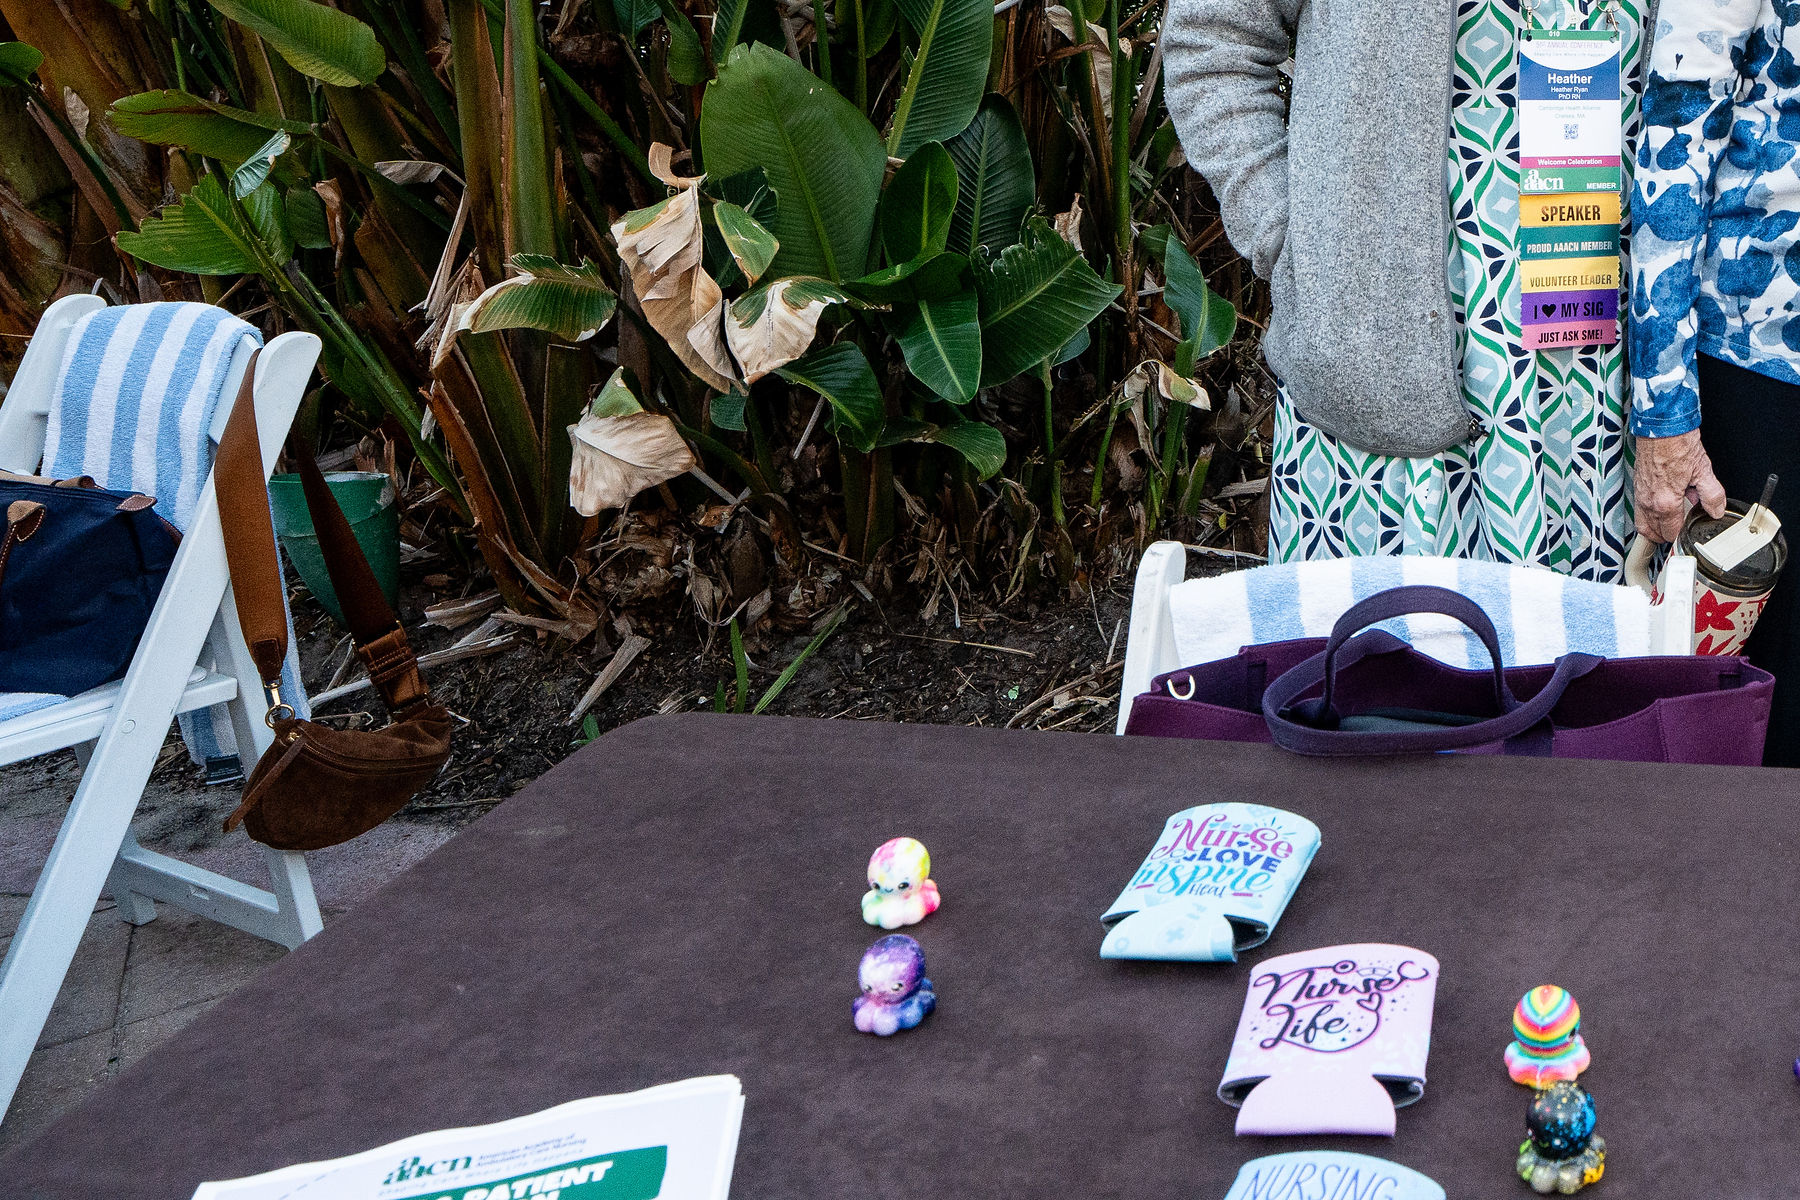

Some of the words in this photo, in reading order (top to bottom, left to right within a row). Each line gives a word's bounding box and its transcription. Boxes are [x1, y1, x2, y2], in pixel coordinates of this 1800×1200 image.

[1547, 73, 1592, 84] Heather
[1541, 205, 1600, 222] SPEAKER
[1527, 243, 1552, 254] PROUD
[1553, 242, 1579, 253] AAACN
[1581, 241, 1613, 251] MEMBER
[1530, 275, 1578, 287] VOLUNTEER
[1580, 274, 1612, 285] LEADER
[1534, 305, 1537, 319] I
[1561, 303, 1579, 318] MY
[1583, 301, 1604, 317] SIG
[1538, 332, 1560, 343] JUST
[1562, 330, 1579, 342] ASK
[1581, 329, 1603, 341] SME!
[1150, 813, 1294, 860] Nurse
[1197, 847, 1282, 873] LOVE
[1132, 860, 1273, 897] inspire
[1252, 963, 1400, 1010] Nurse
[1260, 1003, 1350, 1050] Life
[462, 1160, 614, 1200] PATIENT
[1239, 1163, 1398, 1200] NURSING
